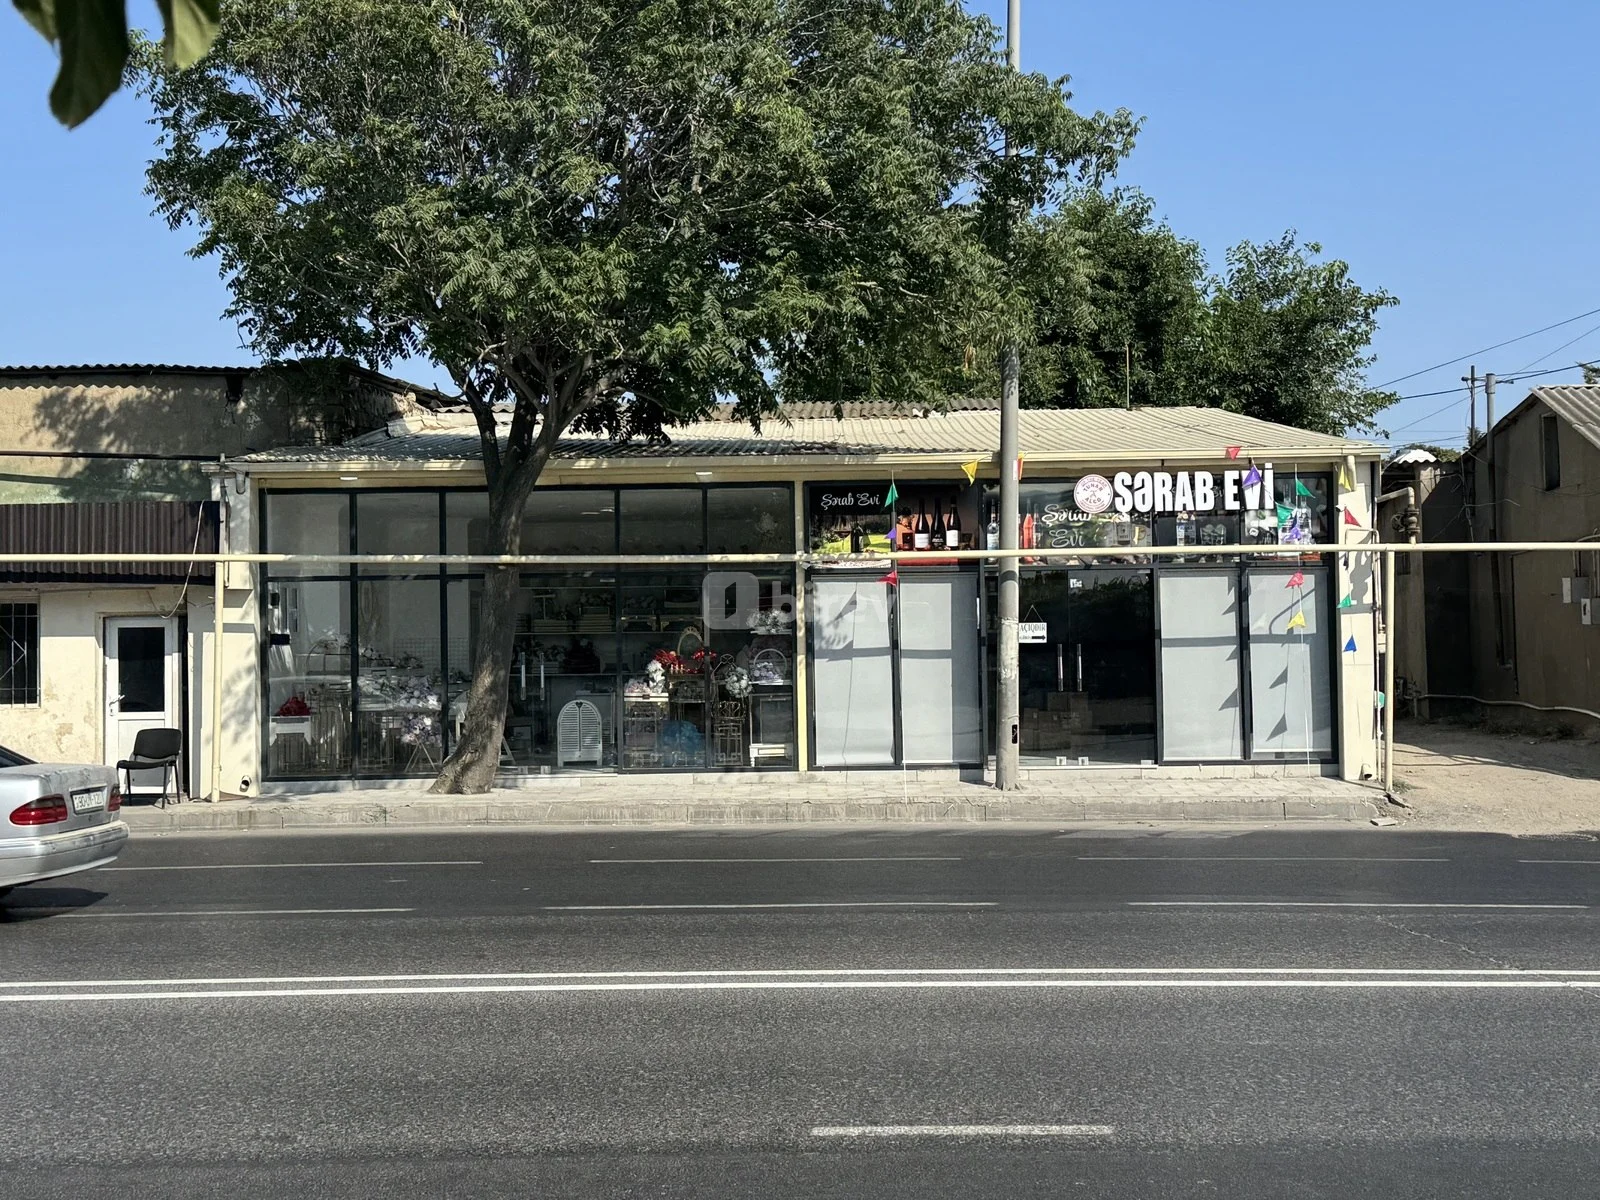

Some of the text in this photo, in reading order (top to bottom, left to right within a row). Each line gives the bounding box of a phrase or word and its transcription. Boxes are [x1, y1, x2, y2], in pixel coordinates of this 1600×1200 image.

[1224, 462, 1274, 511] EVİ
[820, 493, 881, 511] Şərab Evi
[1048, 528, 1086, 548] Evi
